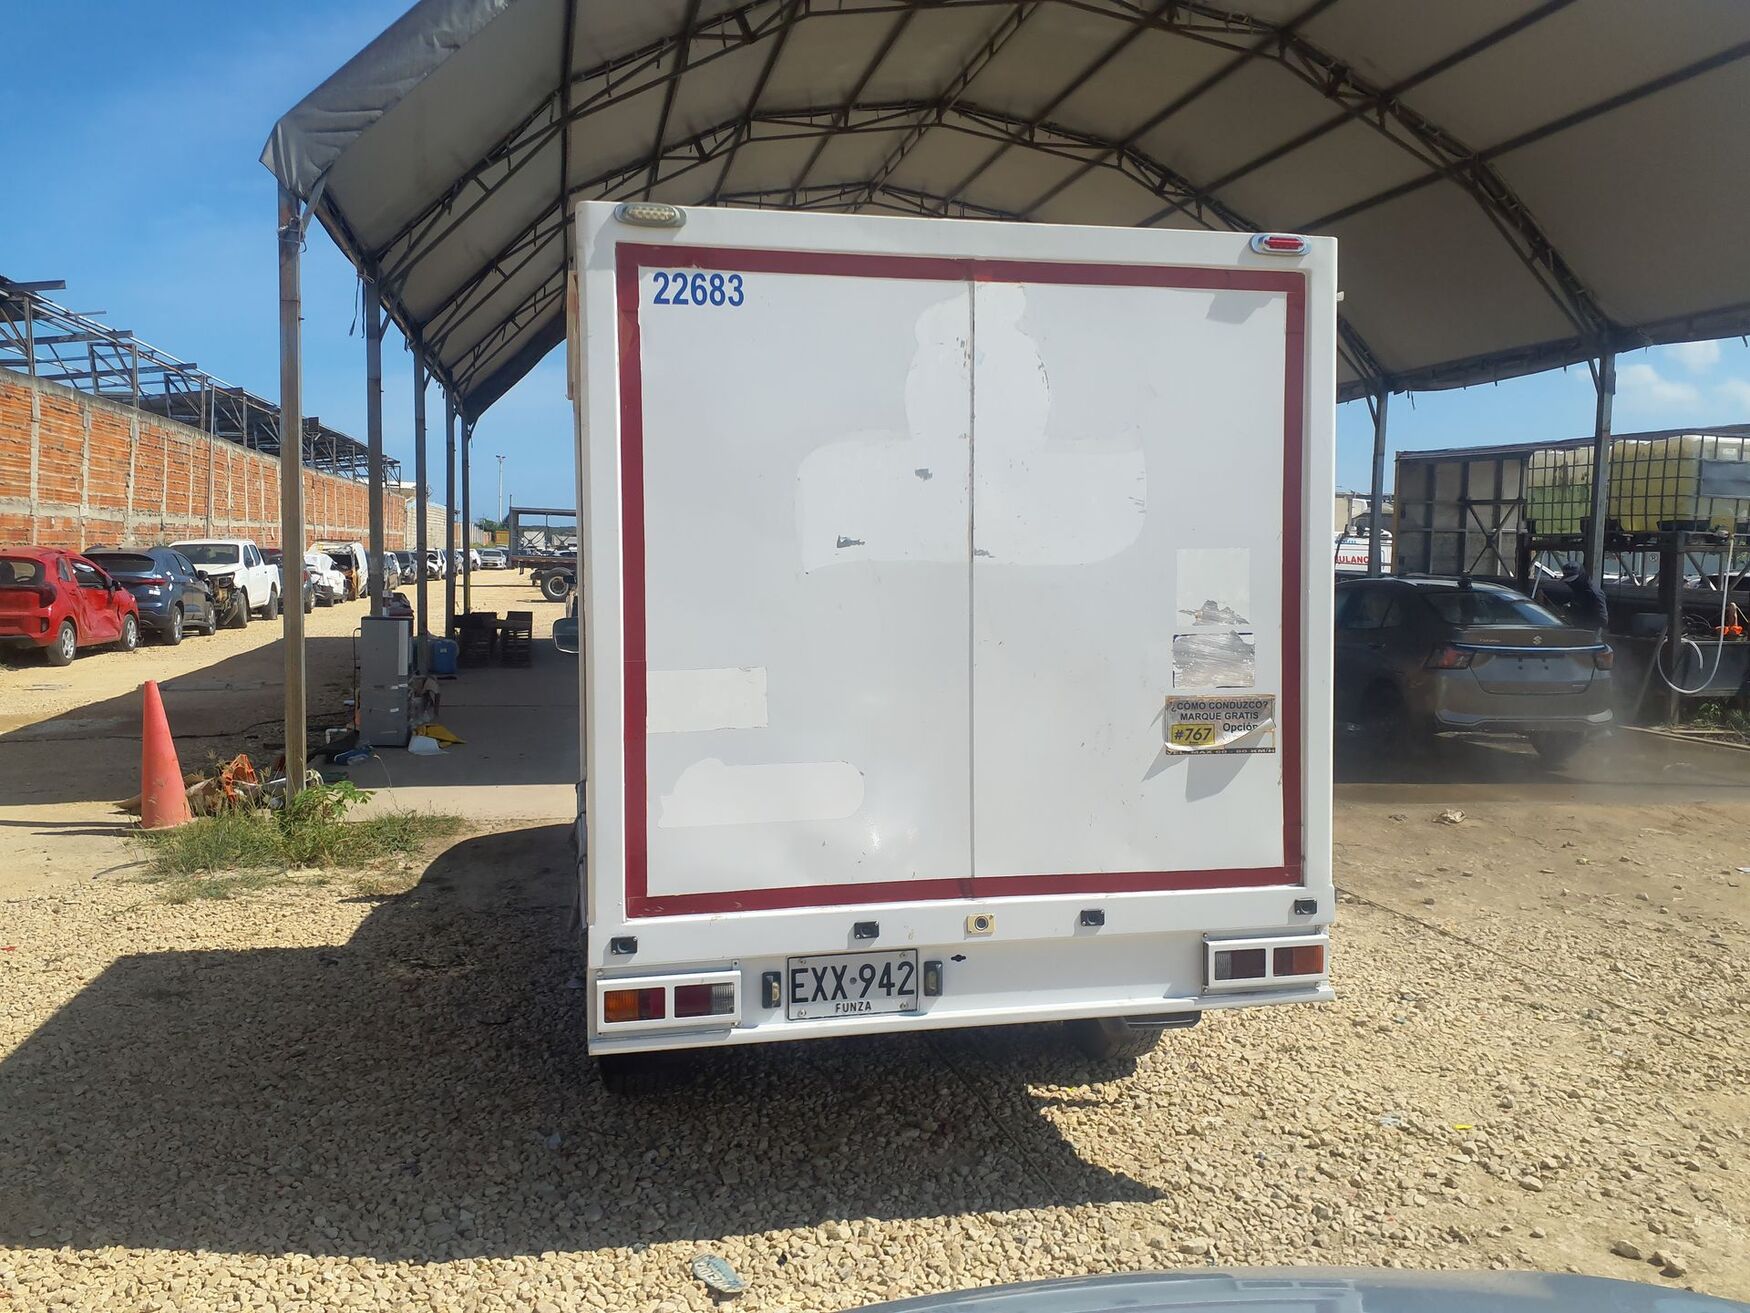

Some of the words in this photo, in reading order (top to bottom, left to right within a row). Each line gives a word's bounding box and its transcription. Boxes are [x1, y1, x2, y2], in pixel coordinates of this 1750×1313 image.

[653, 272, 744, 306] 22683
[1209, 701, 1268, 710] CONDUZCO?
[1180, 713, 1221, 721] MARQUE
[1224, 712, 1259, 720] GRATIS
[1174, 727, 1212, 741] #767
[835, 1001, 872, 1013] FUNZA
